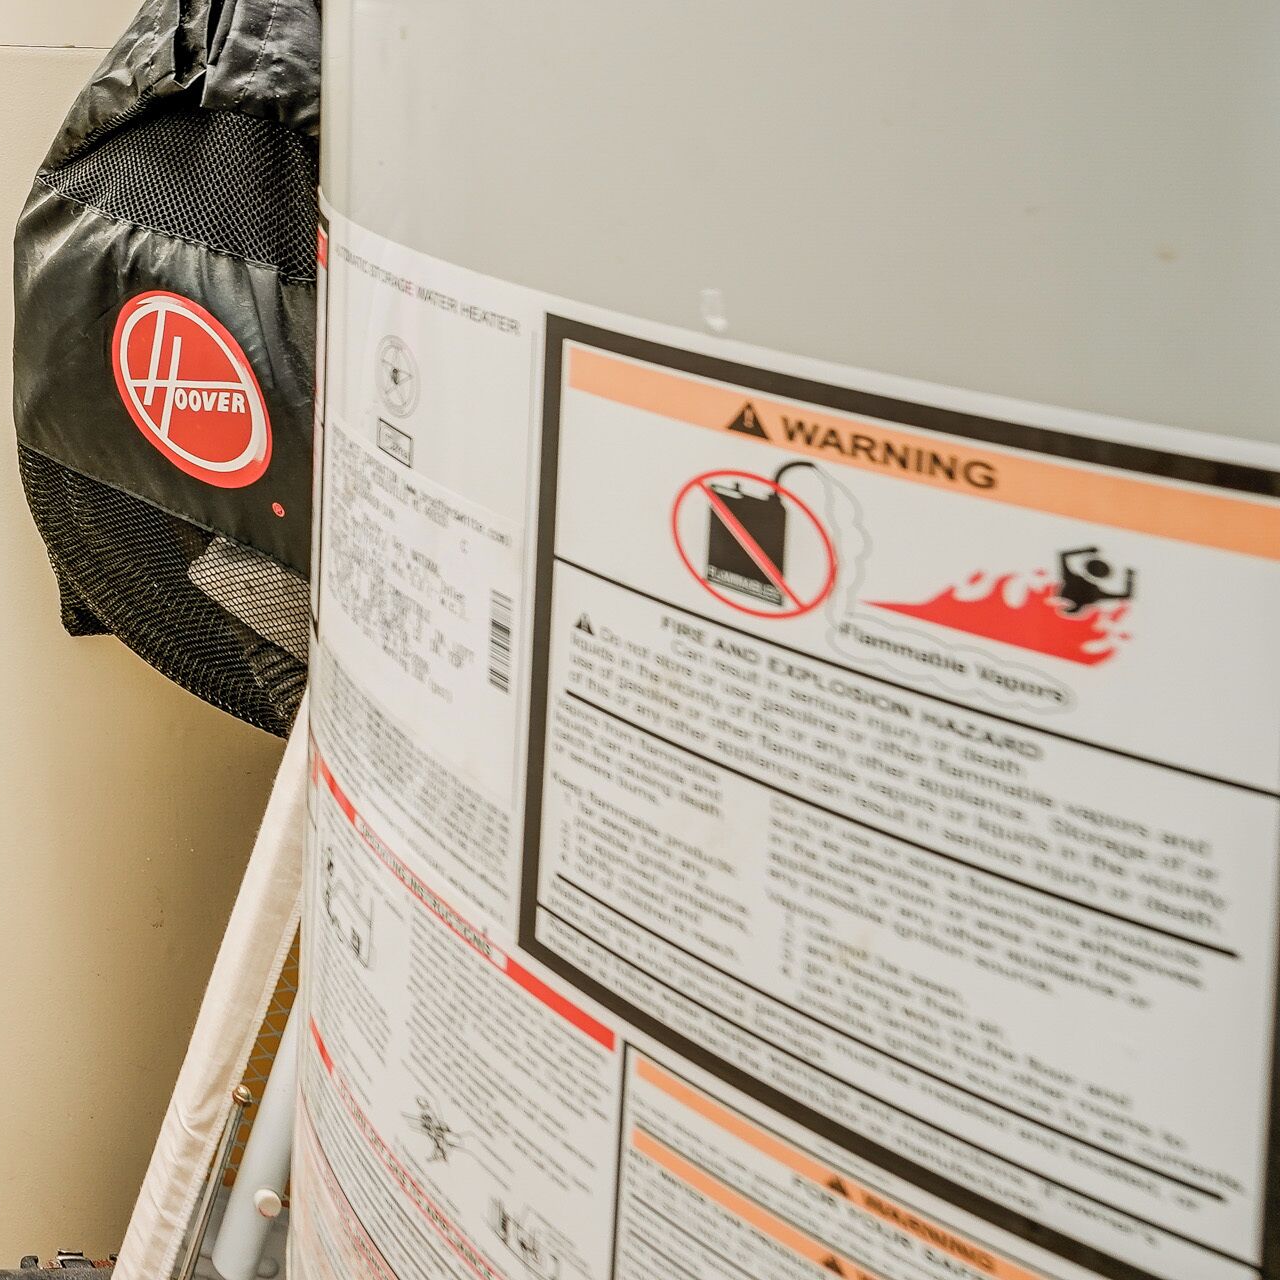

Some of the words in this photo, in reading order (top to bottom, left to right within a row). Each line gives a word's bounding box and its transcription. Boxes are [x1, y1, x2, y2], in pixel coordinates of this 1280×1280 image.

[415, 285, 459, 313] WATER
[459, 303, 521, 337] HEATER
[779, 412, 999, 492] WARNING
[712, 639, 759, 665] AND
[767, 658, 913, 719] EXPLOSION
[839, 621, 967, 673] Flammable
[975, 662, 1064, 703] Vapors
[861, 1191, 995, 1272] WARNING
